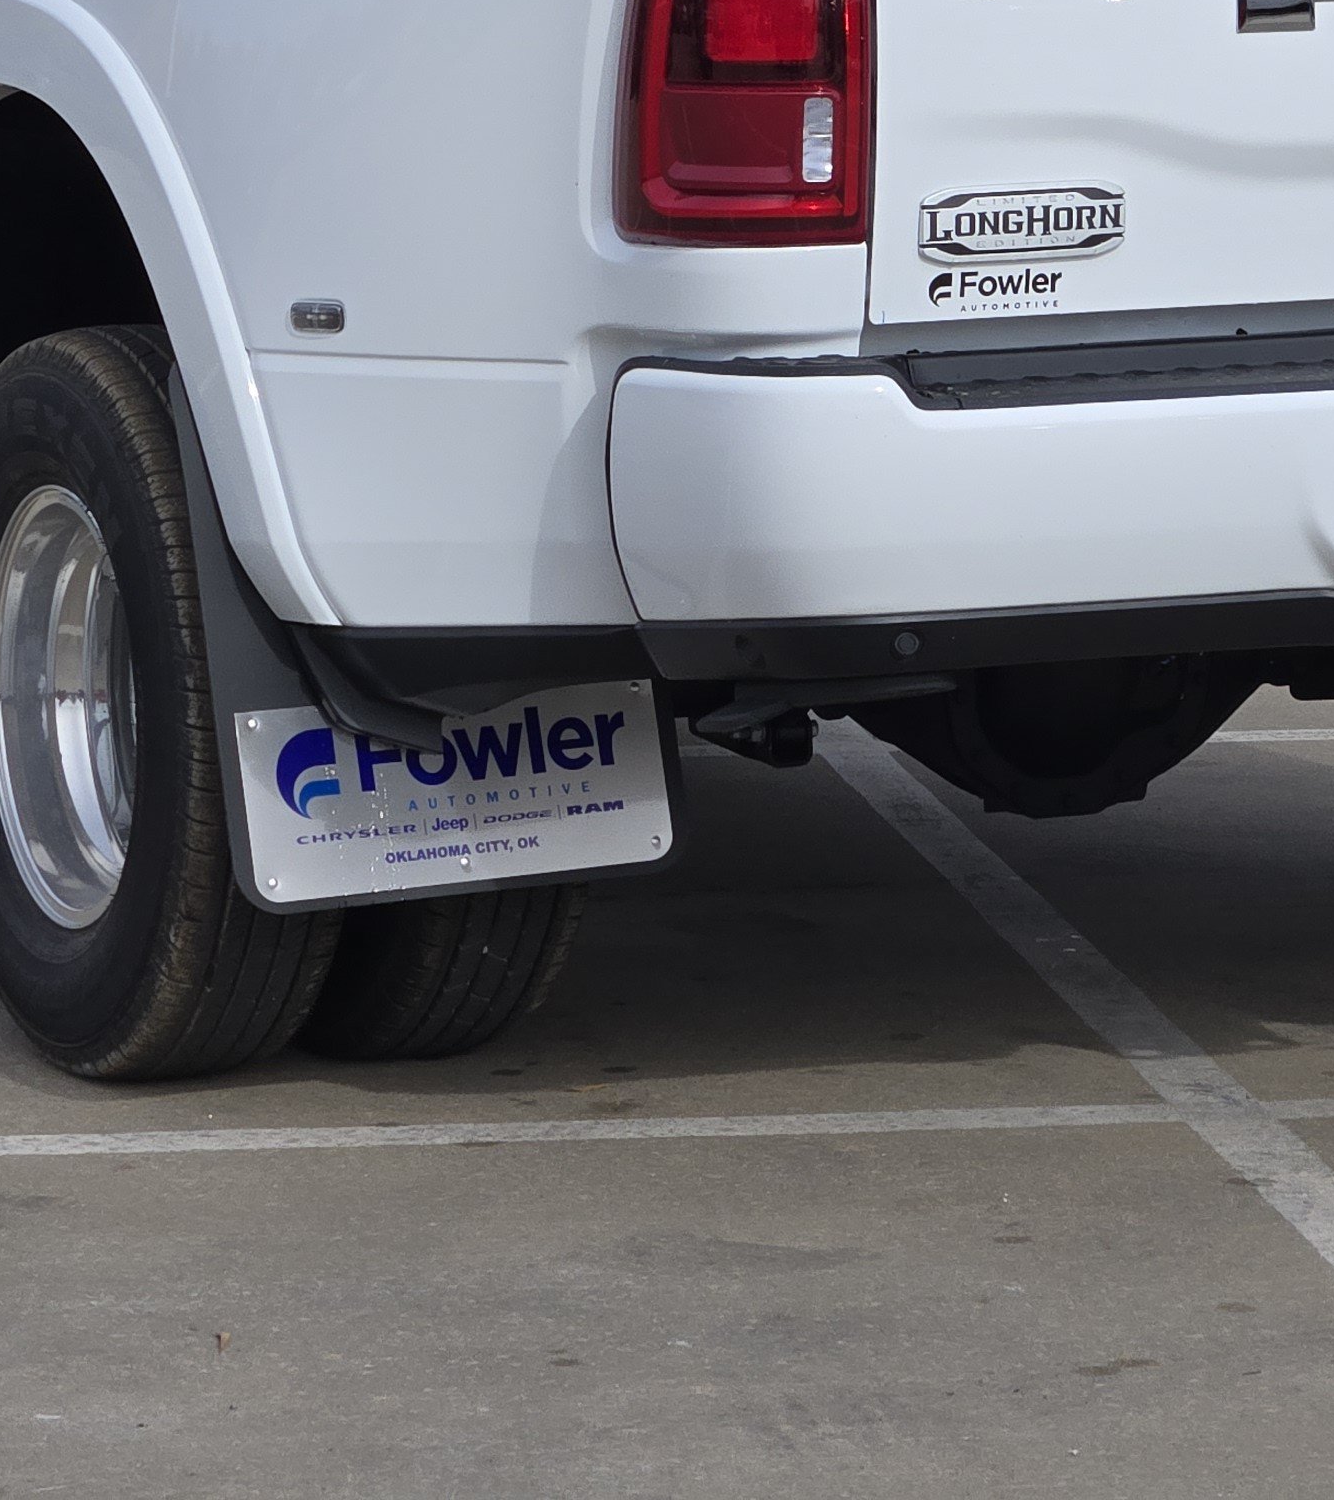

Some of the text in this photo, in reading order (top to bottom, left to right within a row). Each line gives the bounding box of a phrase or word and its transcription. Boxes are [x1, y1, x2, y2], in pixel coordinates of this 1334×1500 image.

[976, 193, 1076, 206] LIMITED
[925, 203, 1124, 243] LONGHORN
[976, 235, 1076, 249] EDITION
[959, 268, 1062, 298] Fowler
[960, 299, 1059, 313] AUTOMOTIVE
[408, 781, 592, 812] AUTOMOTIVE
[296, 799, 624, 845] CHRYSLER Jeep DODGE RAM
[385, 835, 540, 864] OKLAHOMA CITY, OK
